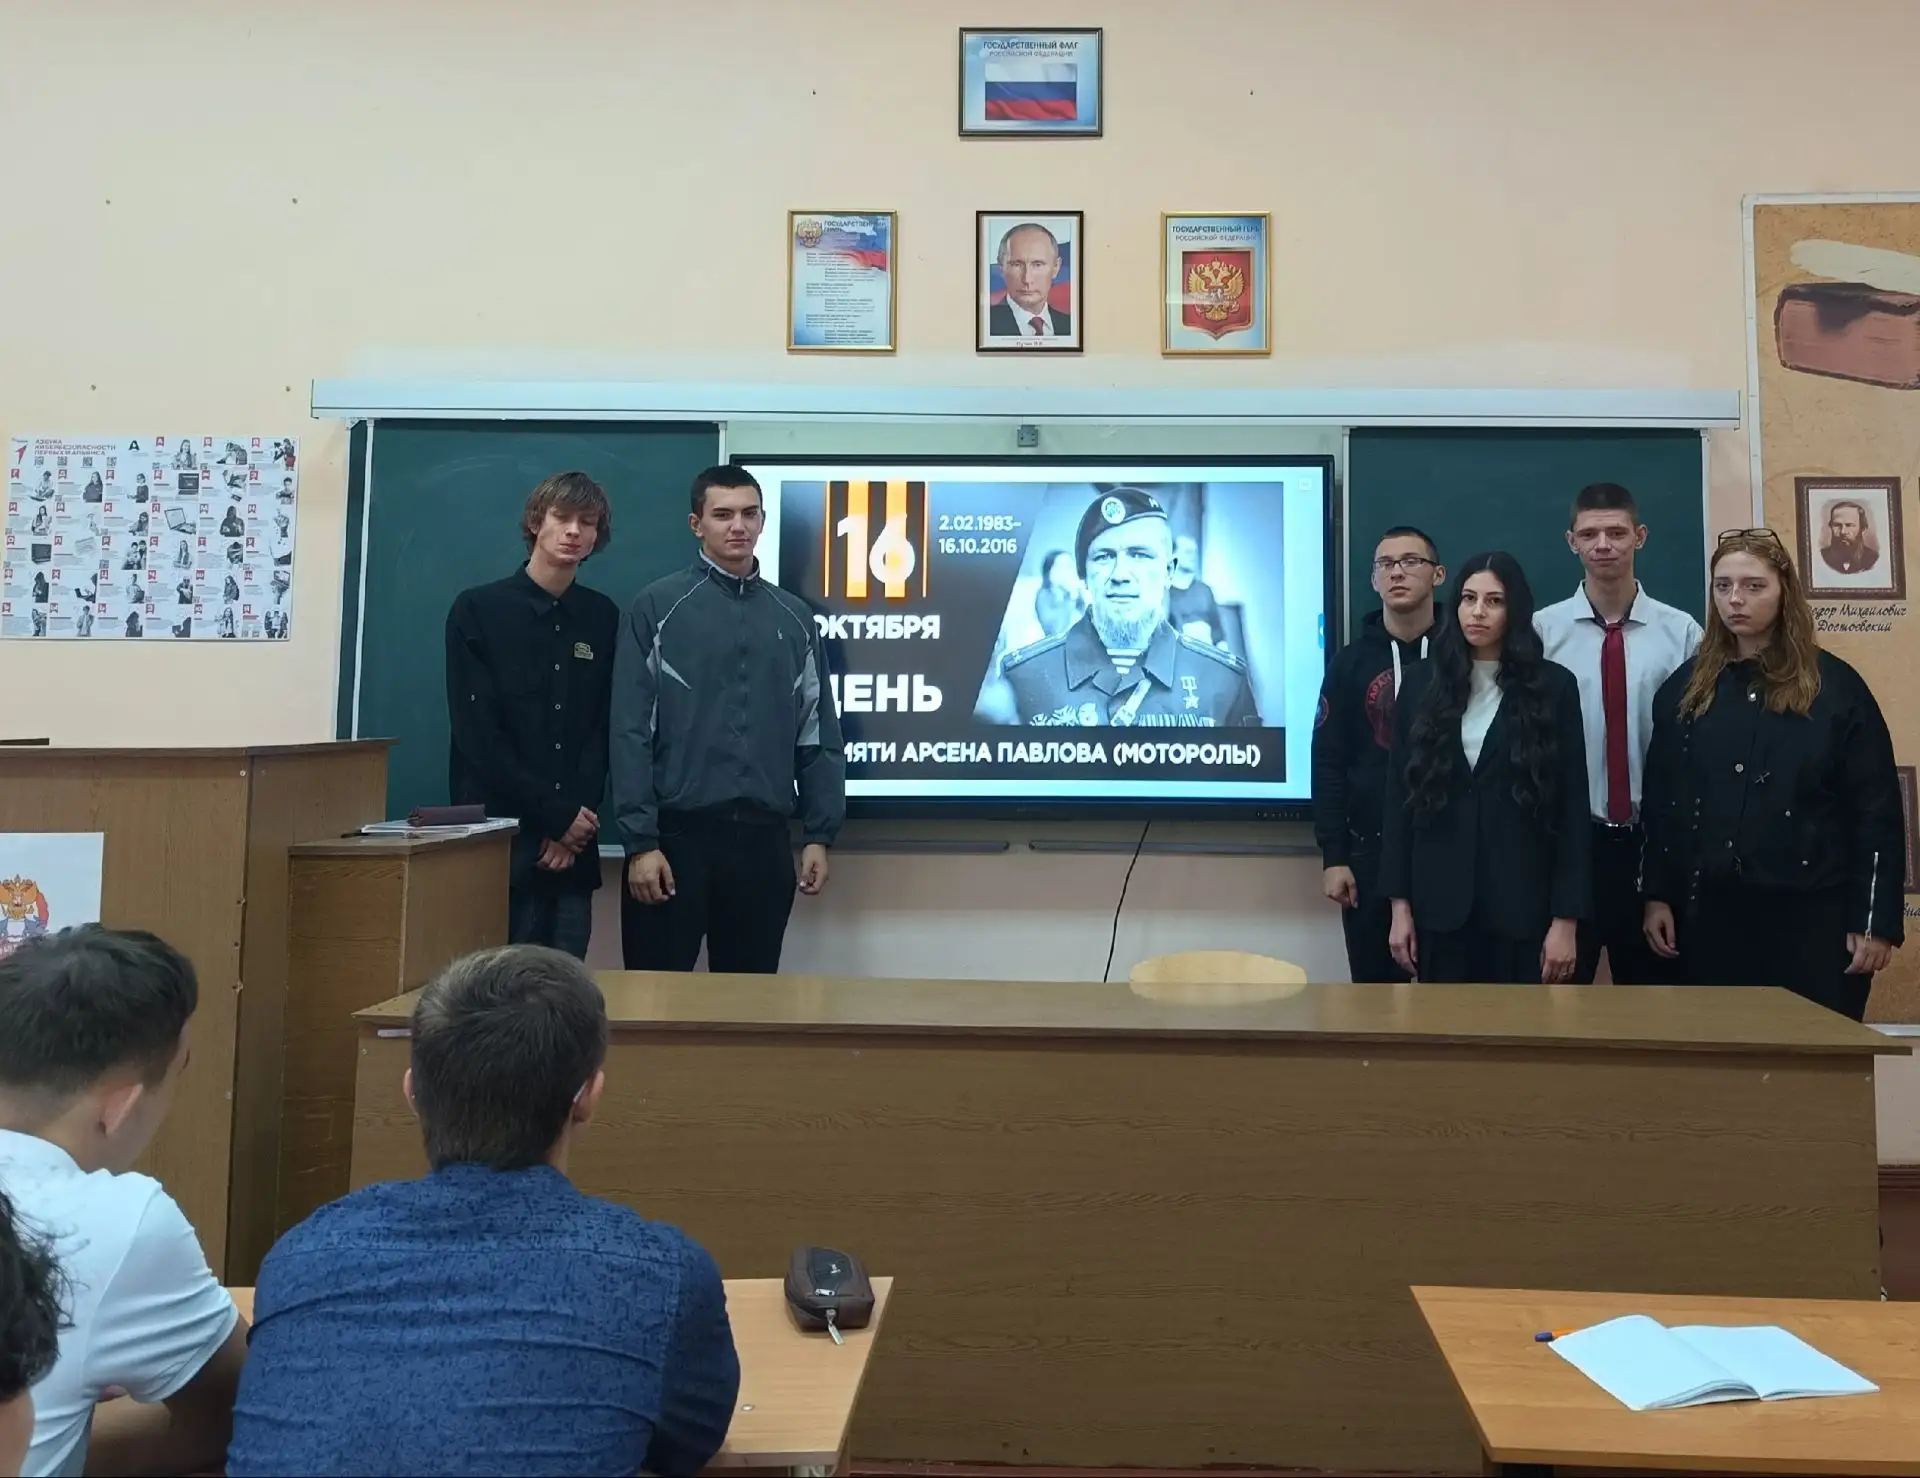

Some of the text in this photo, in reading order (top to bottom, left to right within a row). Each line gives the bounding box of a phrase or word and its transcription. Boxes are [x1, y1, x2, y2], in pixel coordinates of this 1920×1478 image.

[983, 41, 1057, 50] ГОСУДАРСТВЕННЫЙ
[1172, 224, 1241, 233] ГОСУДАРСТВЕННЫЙ
[837, 513, 915, 584] 16
[938, 538, 1018, 554] 16.10.2016
[901, 742, 993, 763] АРСЕНА
[998, 742, 1107, 763] ПАВЛОВА
[1113, 742, 1261, 767] (МОТОРОЛЫ)
